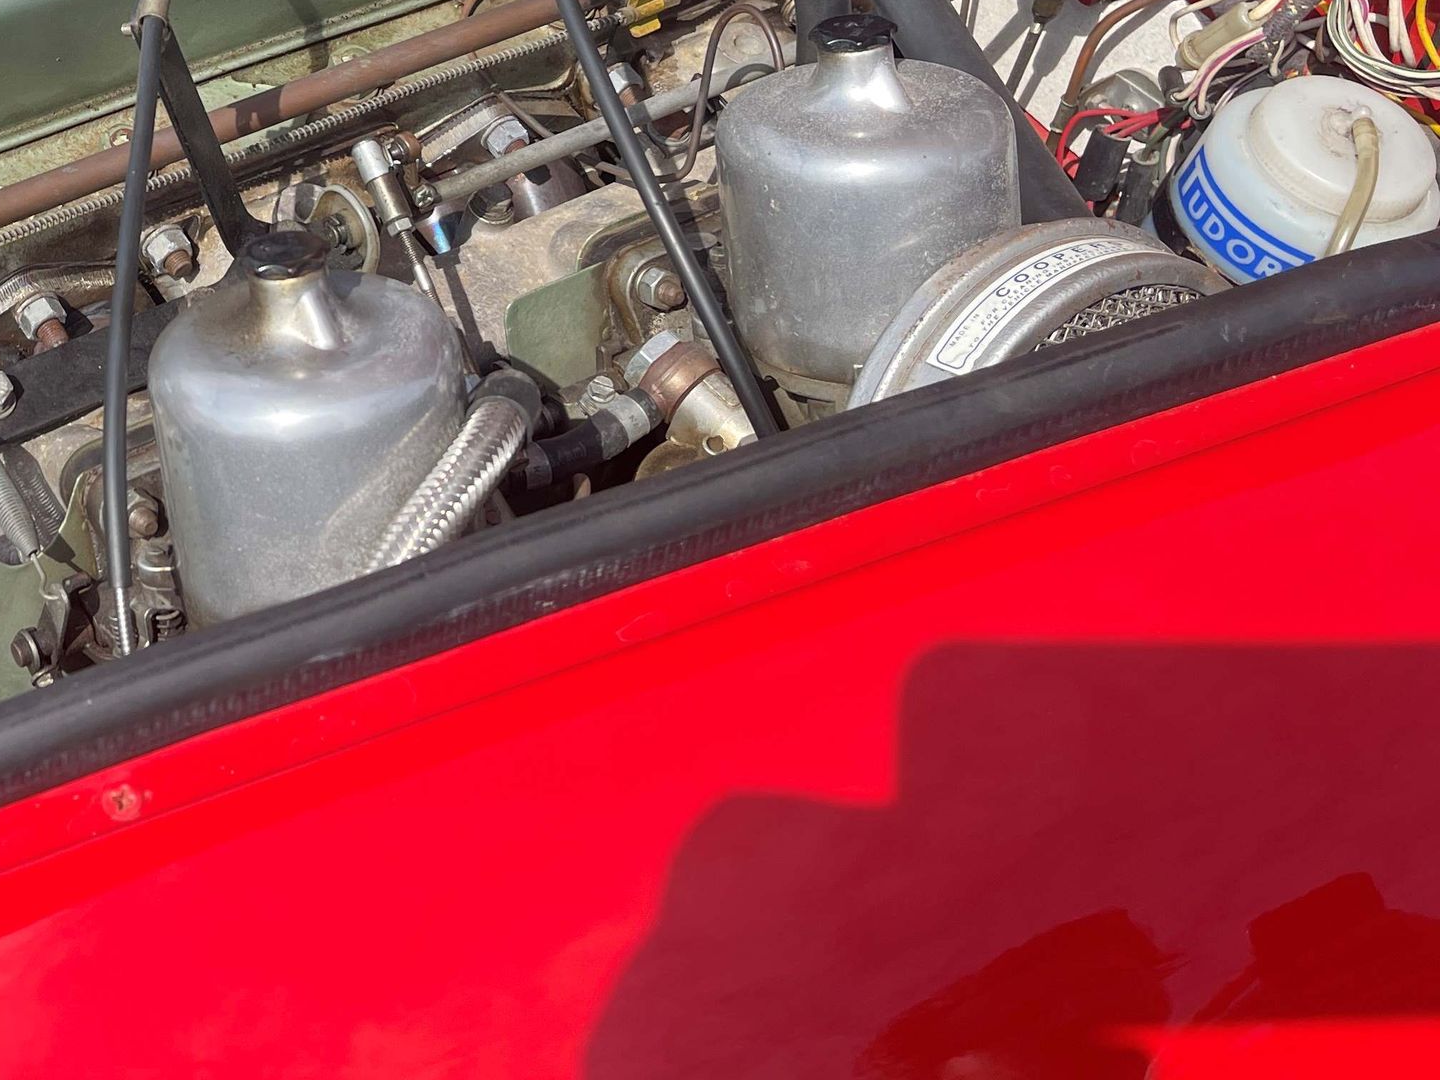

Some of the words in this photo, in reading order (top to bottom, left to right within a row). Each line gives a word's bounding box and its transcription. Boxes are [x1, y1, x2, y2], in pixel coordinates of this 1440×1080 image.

[1182, 154, 1282, 277] TUDOR
[969, 336, 980, 348] TO
[983, 314, 1000, 332] THE
[1002, 279, 1042, 311] VEHICLE
[980, 308, 998, 325] FOR
[1002, 268, 1049, 305] CLEANING
[949, 324, 969, 346] MADE
